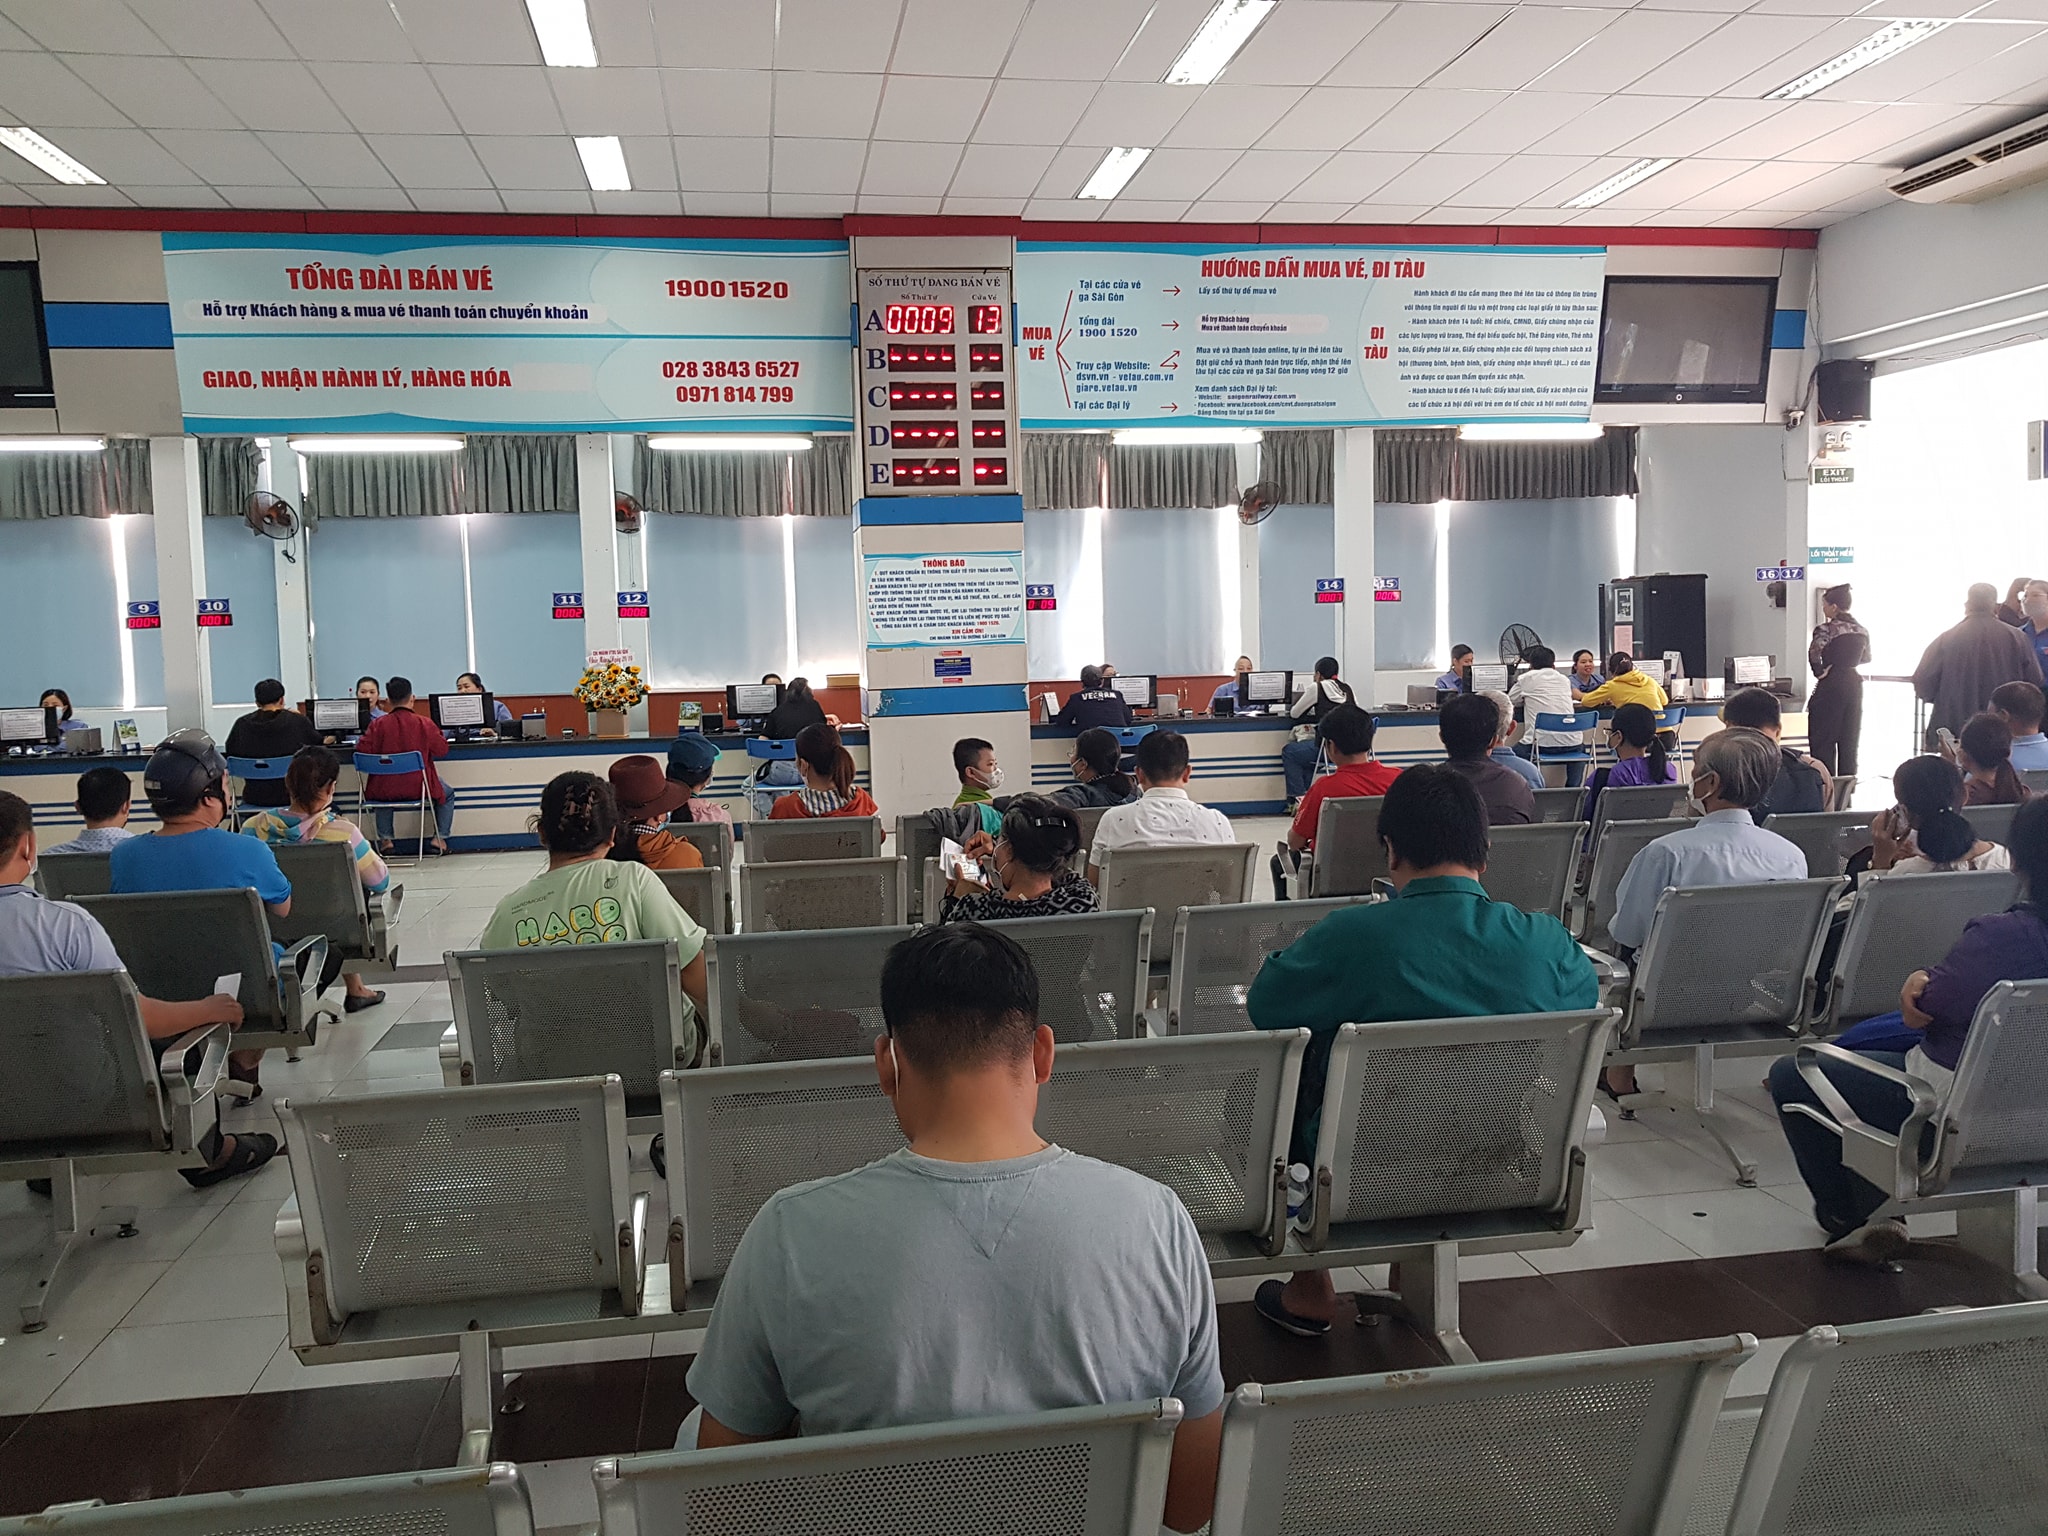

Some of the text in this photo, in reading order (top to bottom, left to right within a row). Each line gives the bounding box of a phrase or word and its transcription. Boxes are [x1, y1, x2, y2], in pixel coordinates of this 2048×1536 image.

[1201, 256, 1425, 279] HƯỚNG DẪN MUA VÉ, ĐI TÀU
[285, 261, 493, 291] TỔNG ĐÀI BÁN VÉ
[868, 274, 1001, 288] SỐ THỨ TỰ ĐANG BÁN VÉ
[1080, 279, 1141, 290] Tại các cửa vé
[1079, 292, 1124, 302] ga Sài Gòn
[203, 300, 588, 320] Hỗ trợ Khách hàng & mua vé thanh toán chuyển khoản
[864, 310, 885, 331] A
[887, 306, 953, 333] 0009
[977, 306, 1000, 333] 13
[1079, 315, 1115, 327] Tổng đài
[1022, 327, 1052, 340] MUA
[1079, 328, 1138, 337] 1900 1520
[1370, 327, 1384, 340] ĐI
[1029, 345, 1045, 360] VÉ
[1364, 344, 1388, 359] TÀU
[866, 348, 886, 370] B
[662, 361, 800, 378] 028 3843 6527
[1076, 361, 1150, 372] Truy cập Website:
[203, 367, 512, 391] GIAO, NHẬN HÀNH LÝ, HÀNG HÓA
[676, 386, 794, 403] 0971 814 799
[868, 386, 887, 407] C
[1074, 400, 1131, 411] Tại các Đại lý
[868, 425, 890, 446] D
[870, 463, 890, 484] E
[922, 559, 966, 567] THÔNG BÁO
[1762, 569, 1799, 579] 16 17
[1323, 581, 1339, 589] 14
[1379, 580, 1394, 589] 15
[1033, 587, 1049, 596] 13
[560, 595, 576, 604] 11
[624, 595, 642, 603] 12
[138, 604, 150, 613] 9
[205, 601, 223, 611] 10
[555, 608, 582, 618] 0002
[620, 608, 647, 617] 0008
[128, 617, 159, 628] 0004
[200, 615, 230, 626] 0001
